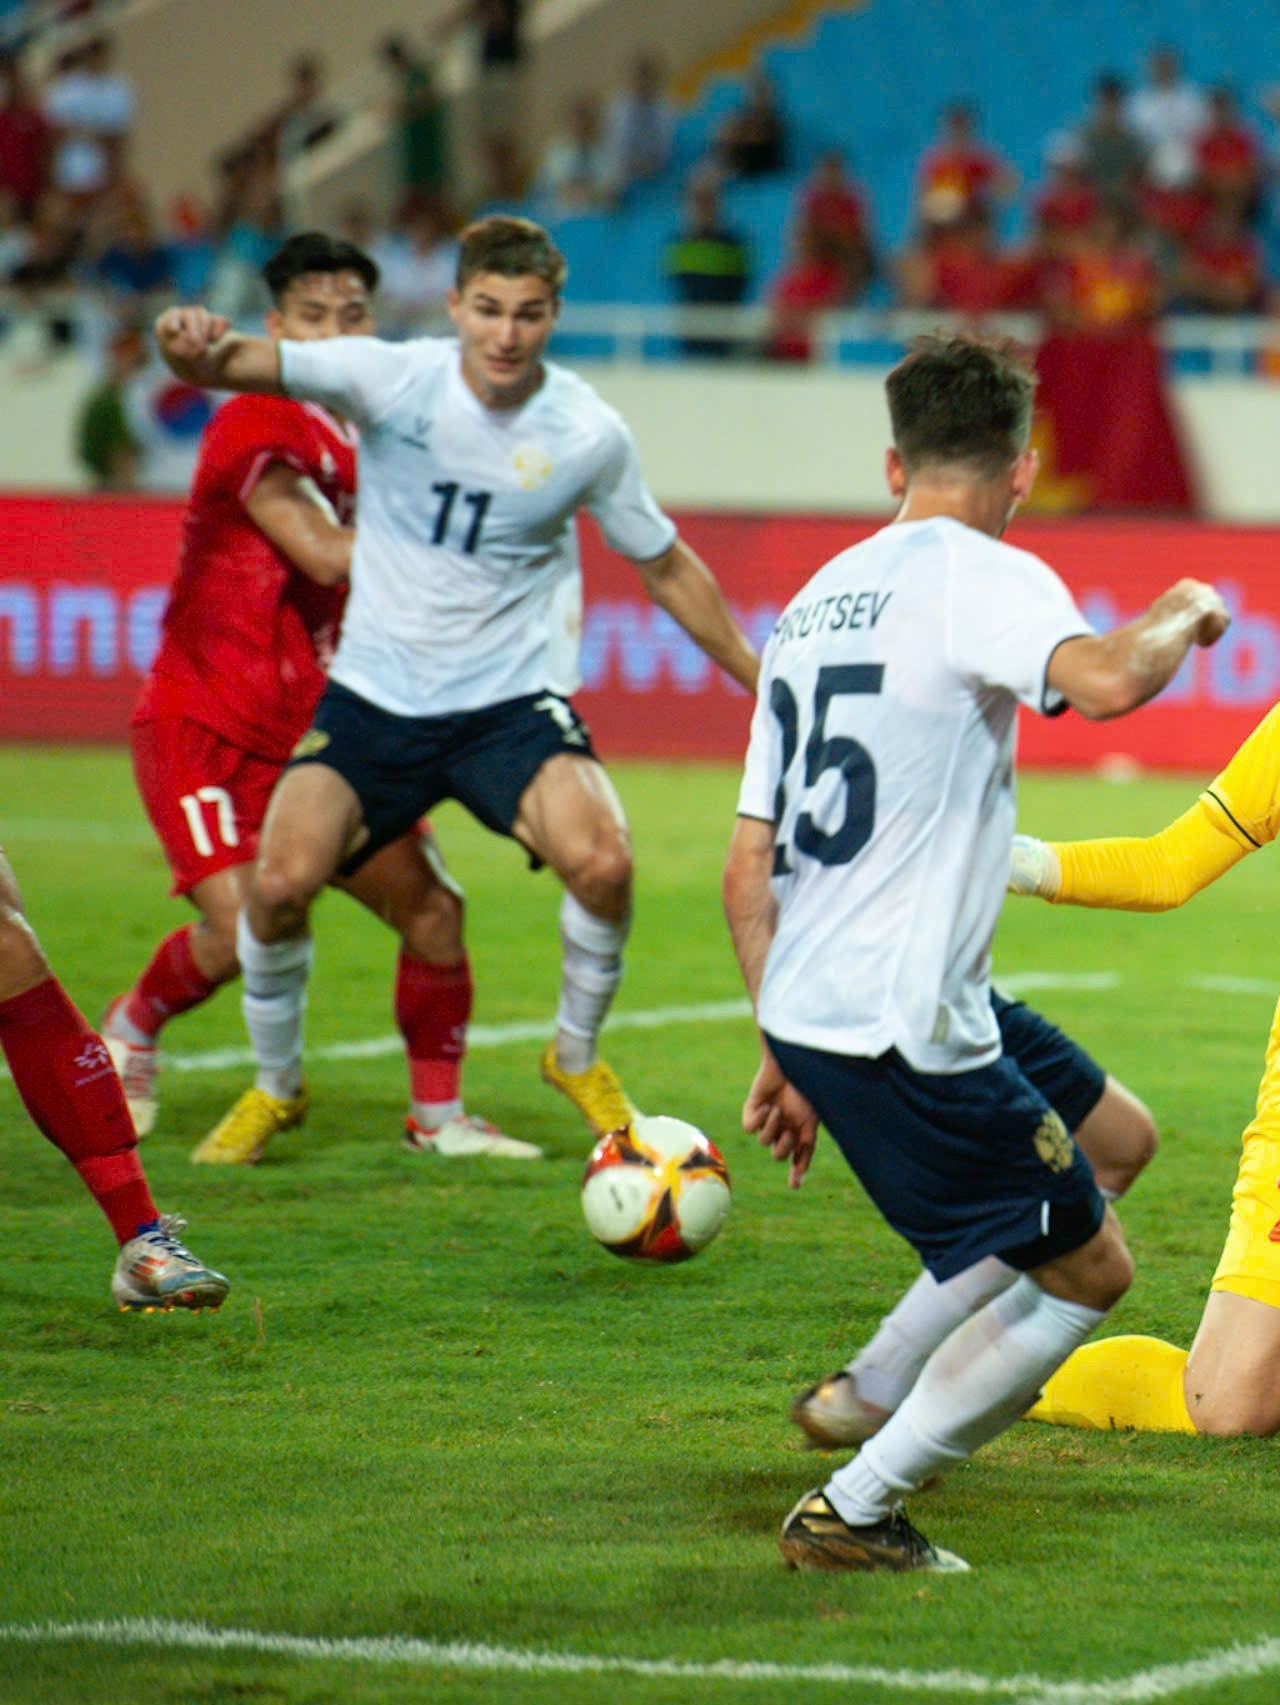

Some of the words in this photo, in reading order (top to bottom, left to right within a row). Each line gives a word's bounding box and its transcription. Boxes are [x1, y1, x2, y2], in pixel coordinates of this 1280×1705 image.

[431, 481, 493, 555] 11
[775, 590, 894, 646] RUTSEV
[179, 786, 239, 857] 17
